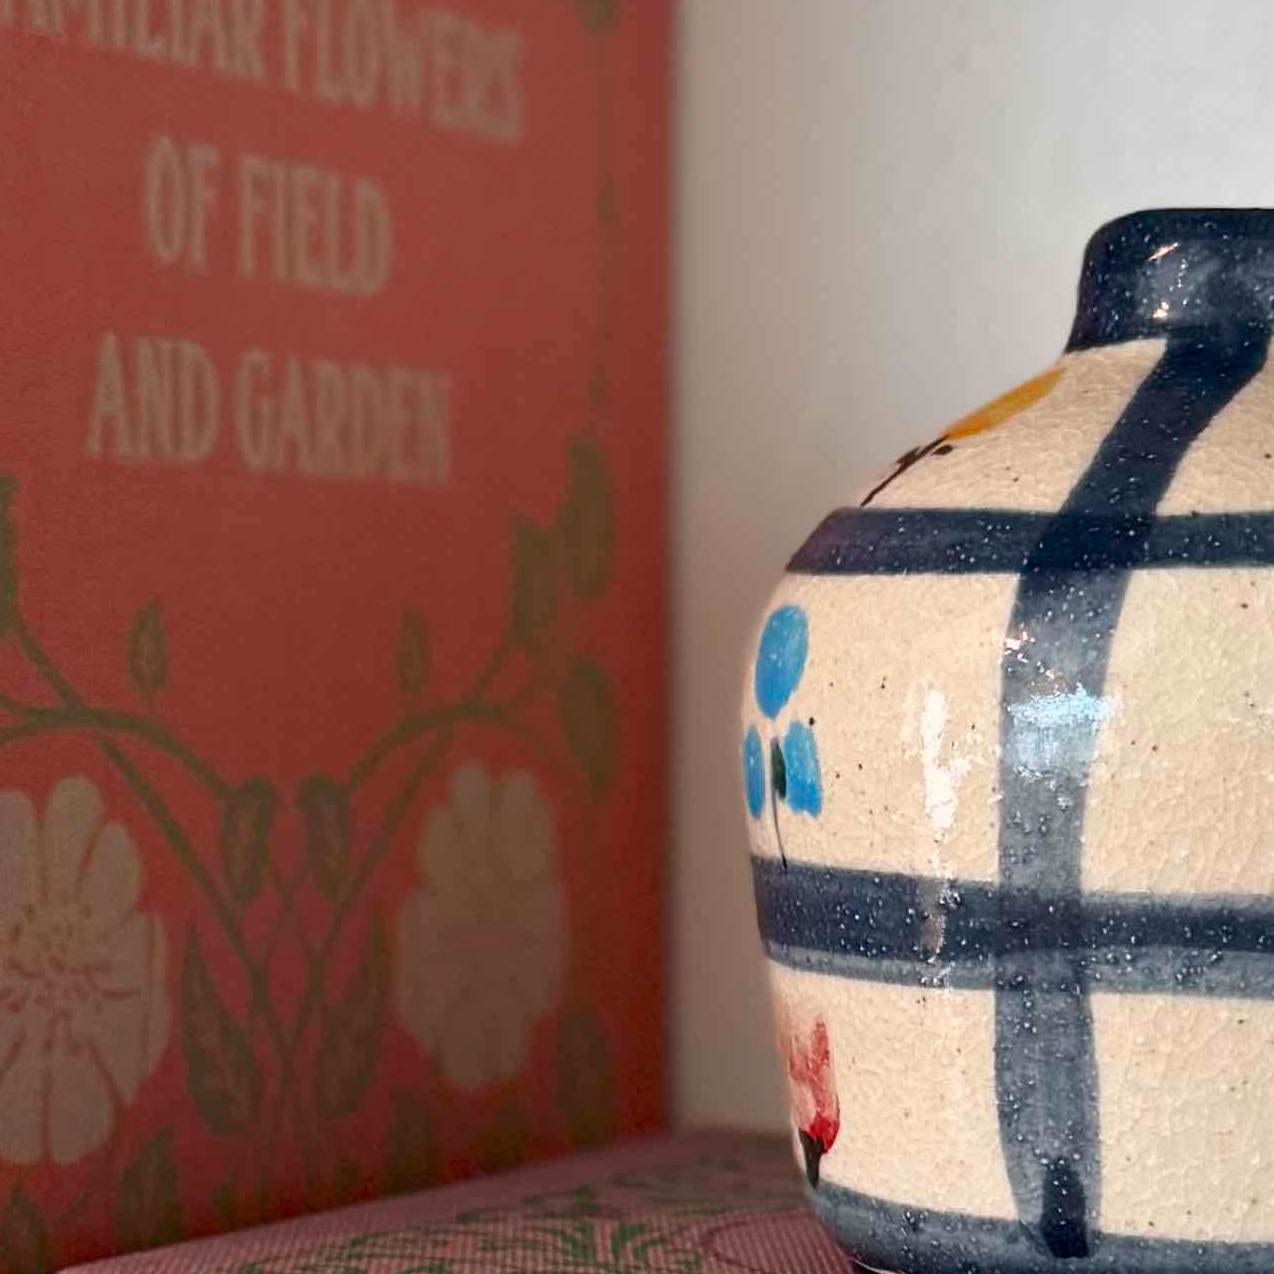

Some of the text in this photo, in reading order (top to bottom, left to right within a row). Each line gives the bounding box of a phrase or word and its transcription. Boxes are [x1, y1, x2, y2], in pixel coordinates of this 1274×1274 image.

[141, 134, 392, 297] OF FIELD
[84, 331, 453, 487] AND GARDEN
